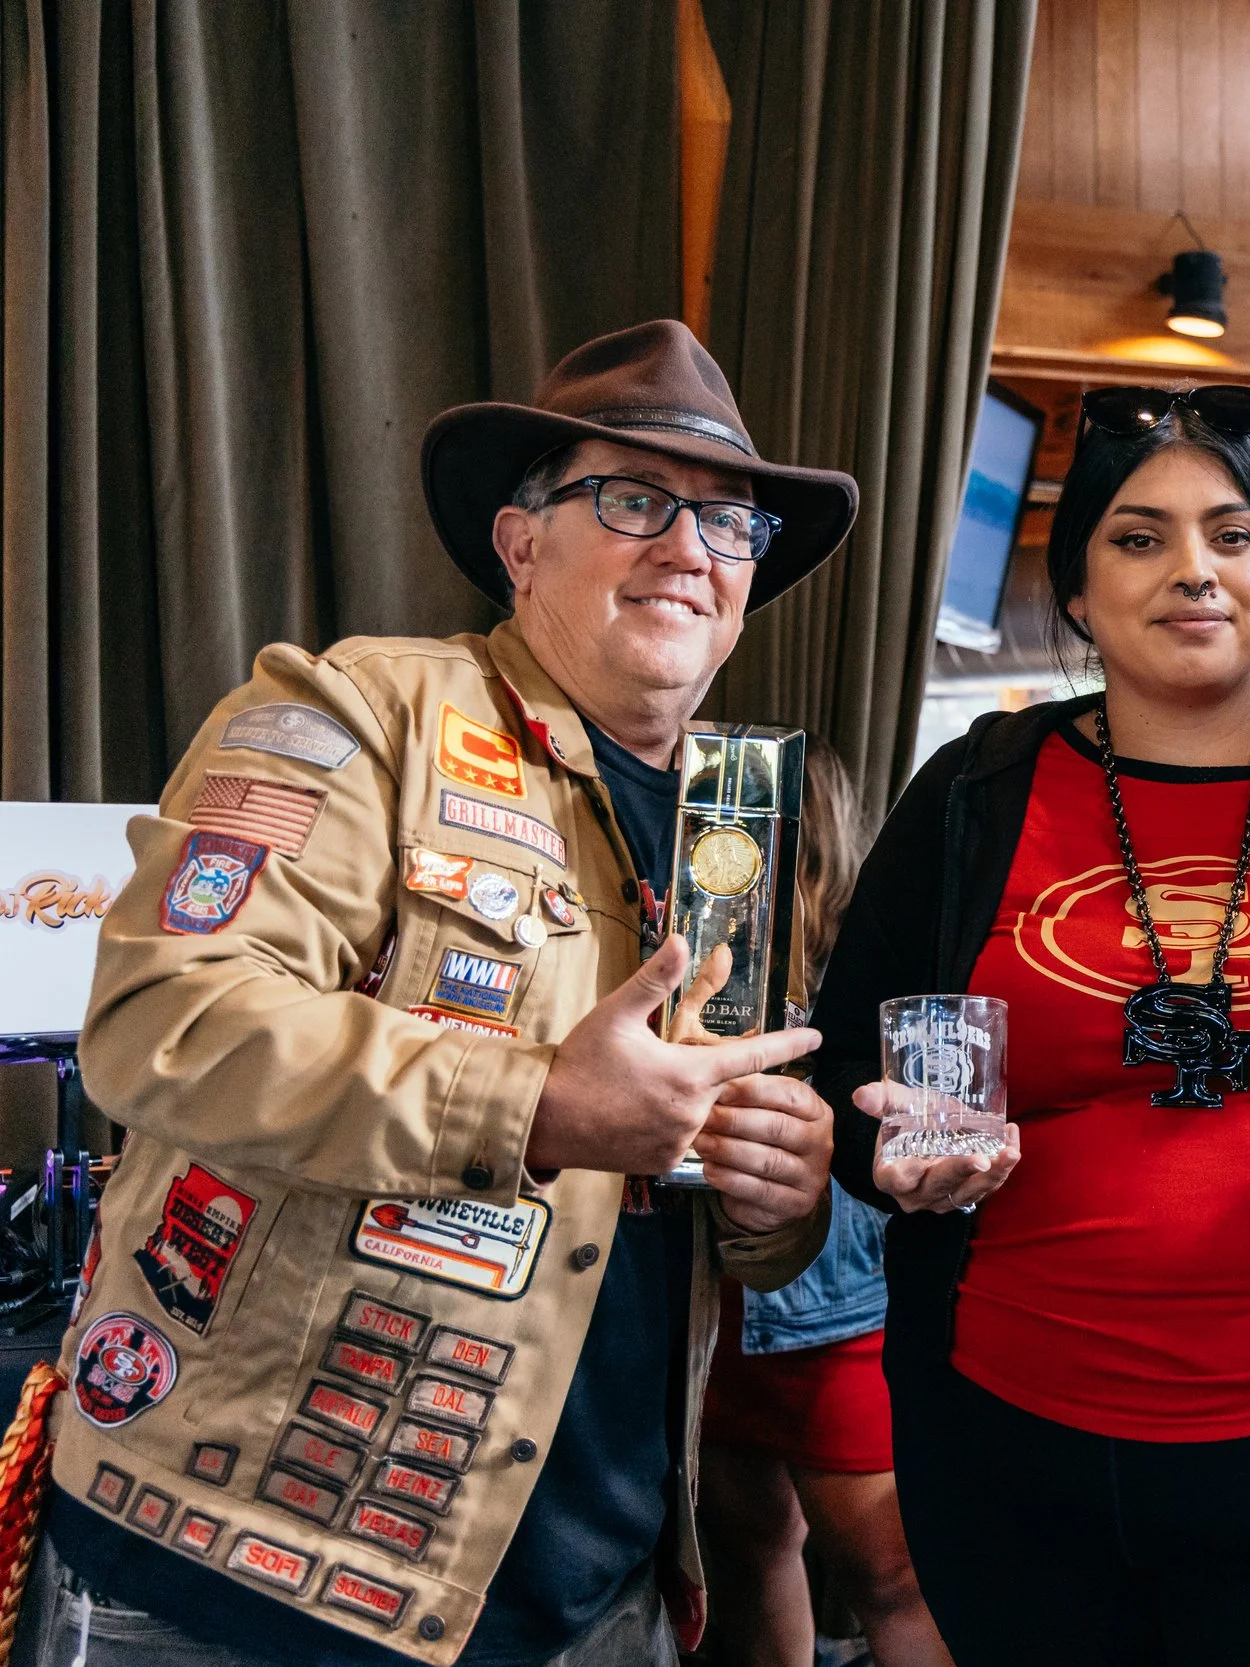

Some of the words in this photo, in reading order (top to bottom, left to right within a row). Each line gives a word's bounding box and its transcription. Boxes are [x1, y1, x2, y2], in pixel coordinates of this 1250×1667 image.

[447, 798, 566, 863] GRILLMASTER
[209, 858, 232, 869] FIRE
[21, 875, 113, 929] Rick
[444, 951, 515, 990] WWII
[439, 981, 458, 992] THE
[460, 987, 507, 1003] NATIONAL
[462, 997, 506, 1013] MUSEUM
[719, 1004, 751, 1017] BAR
[403, 1199, 525, 1236] WNIEVILLE
[364, 1239, 444, 1270] CALIFORNIA
[359, 1306, 415, 1341] STICK
[339, 1346, 395, 1381] TAMPA
[451, 1339, 491, 1369] DEN
[308, 1389, 377, 1430] BUFFALO
[303, 1439, 342, 1469] CLE
[415, 1430, 451, 1458] SEA
[386, 1468, 444, 1500] HEINZ
[357, 1507, 424, 1549] VEGAS
[245, 1543, 302, 1580] SOFI
[334, 1575, 399, 1615] SOLDIER
